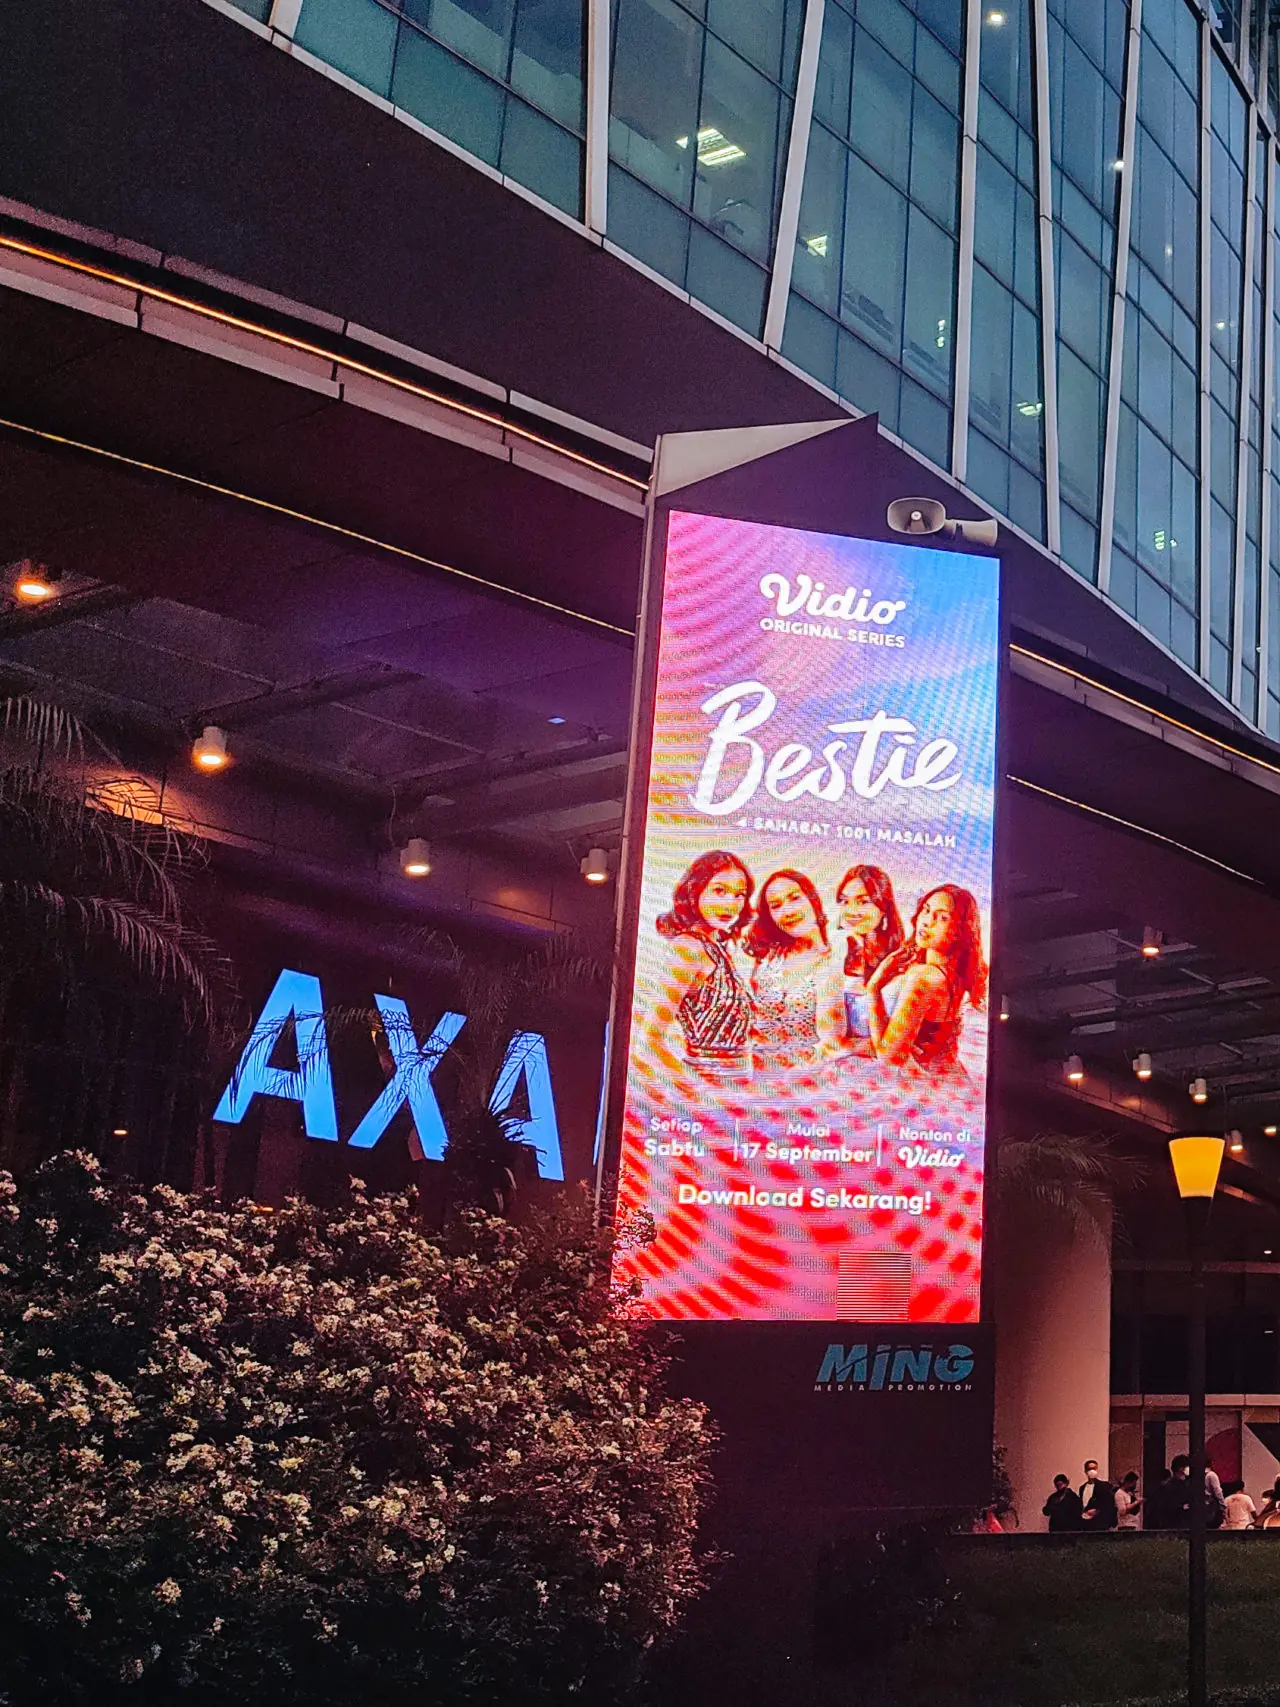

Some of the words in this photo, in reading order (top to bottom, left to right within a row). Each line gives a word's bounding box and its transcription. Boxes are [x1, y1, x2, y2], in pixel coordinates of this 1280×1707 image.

[759, 572, 907, 625] Vidio
[759, 618, 843, 642] ORIGINAL
[847, 627, 906, 648] SERIES
[688, 680, 963, 816] Bestie
[753, 817, 831, 837] SAHABAT
[836, 826, 872, 841] 1001
[877, 828, 957, 848] MASALAH
[213, 968, 564, 1182] AXA
[650, 1116, 703, 1135] Setiap
[786, 1123, 831, 1138] Mulai
[899, 1127, 952, 1142] Nonton
[955, 1127, 971, 1143] di
[643, 1138, 705, 1158] Sabtu
[741, 1142, 755, 1159] 17
[765, 1144, 874, 1165] September
[898, 1145, 965, 1170] Vidio
[678, 1184, 803, 1207] Download
[810, 1187, 932, 1216] Sekarang!
[814, 1384, 865, 1392] MEDIA
[888, 1384, 972, 1392] PROMOTION
